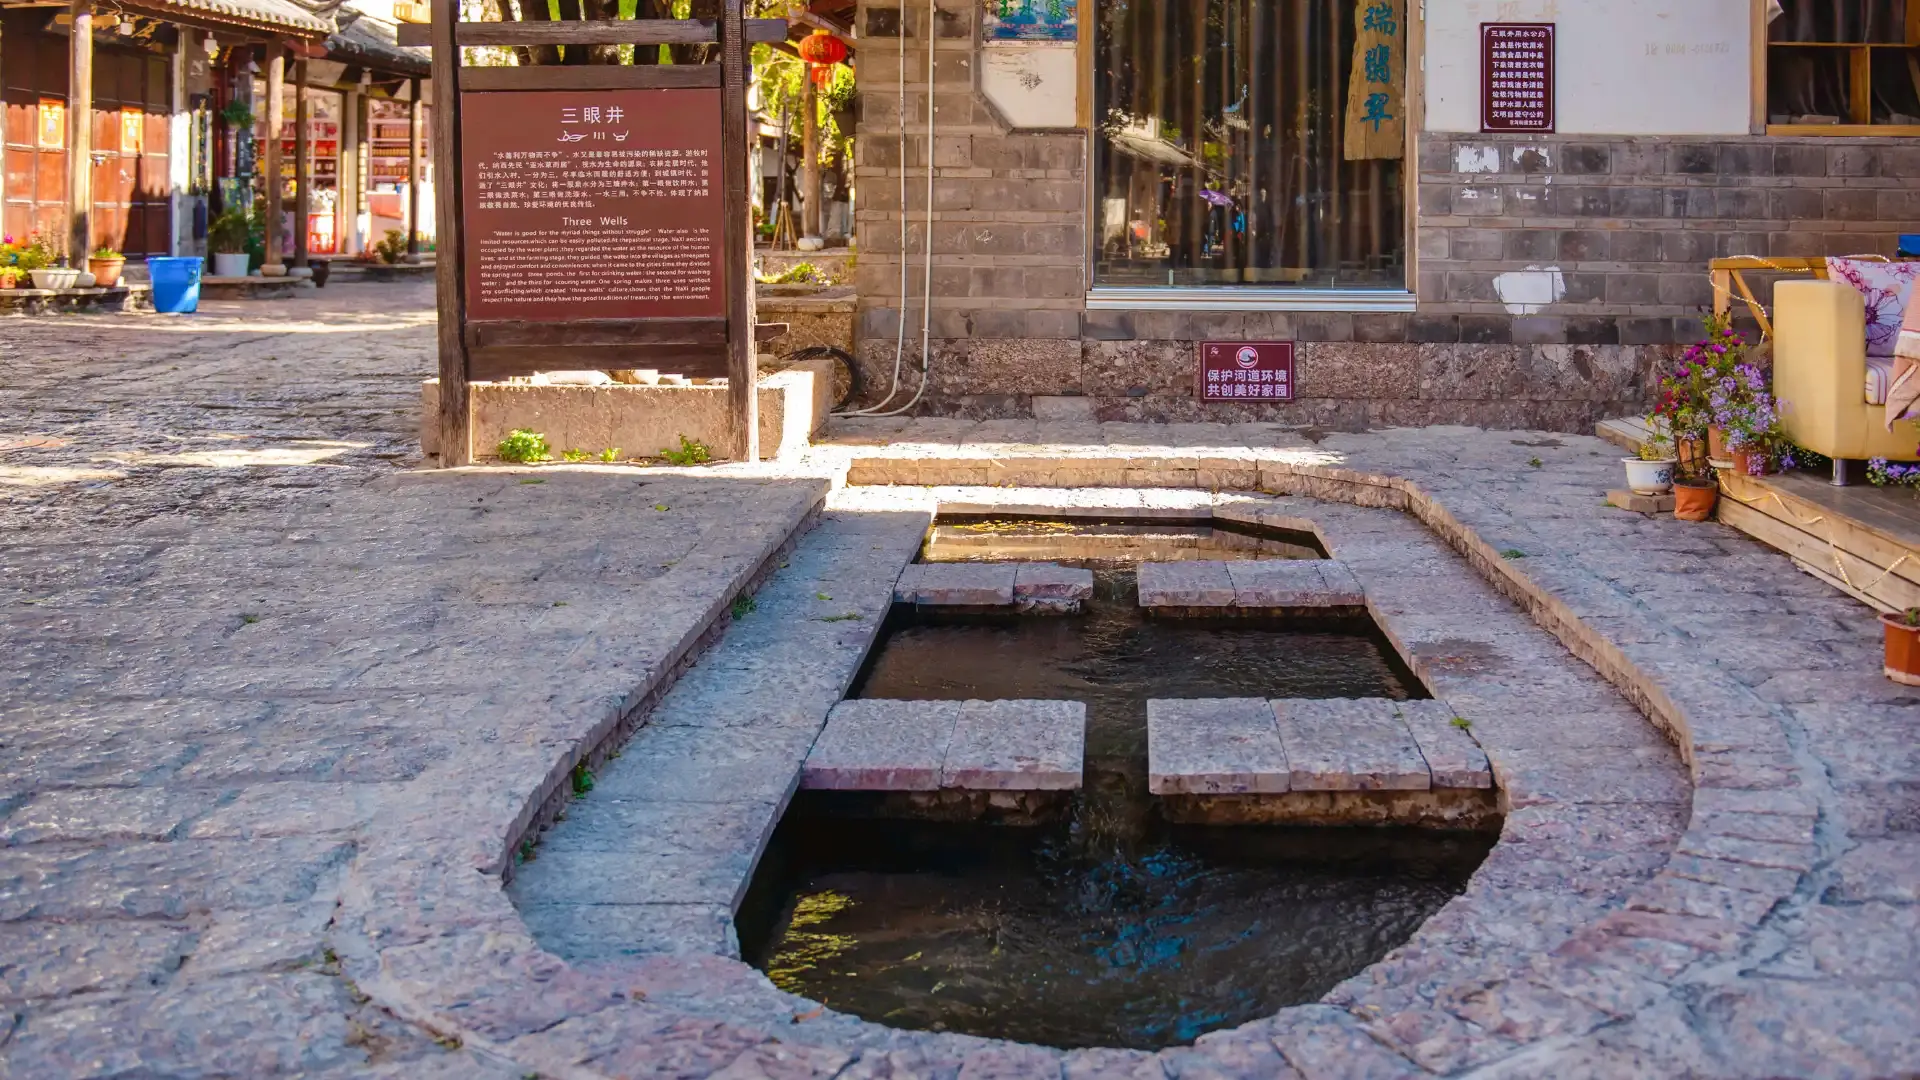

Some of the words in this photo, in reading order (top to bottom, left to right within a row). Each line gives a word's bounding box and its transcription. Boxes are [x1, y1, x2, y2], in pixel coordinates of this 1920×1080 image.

[1360, 2, 1397, 133] 瑞翡翠
[560, 106, 624, 124] 三眼井
[562, 217, 592, 226] Three
[600, 216, 628, 225] Wells
[1208, 370, 1287, 382] 保护河道环境
[1207, 384, 1287, 396] 共创美好家园
